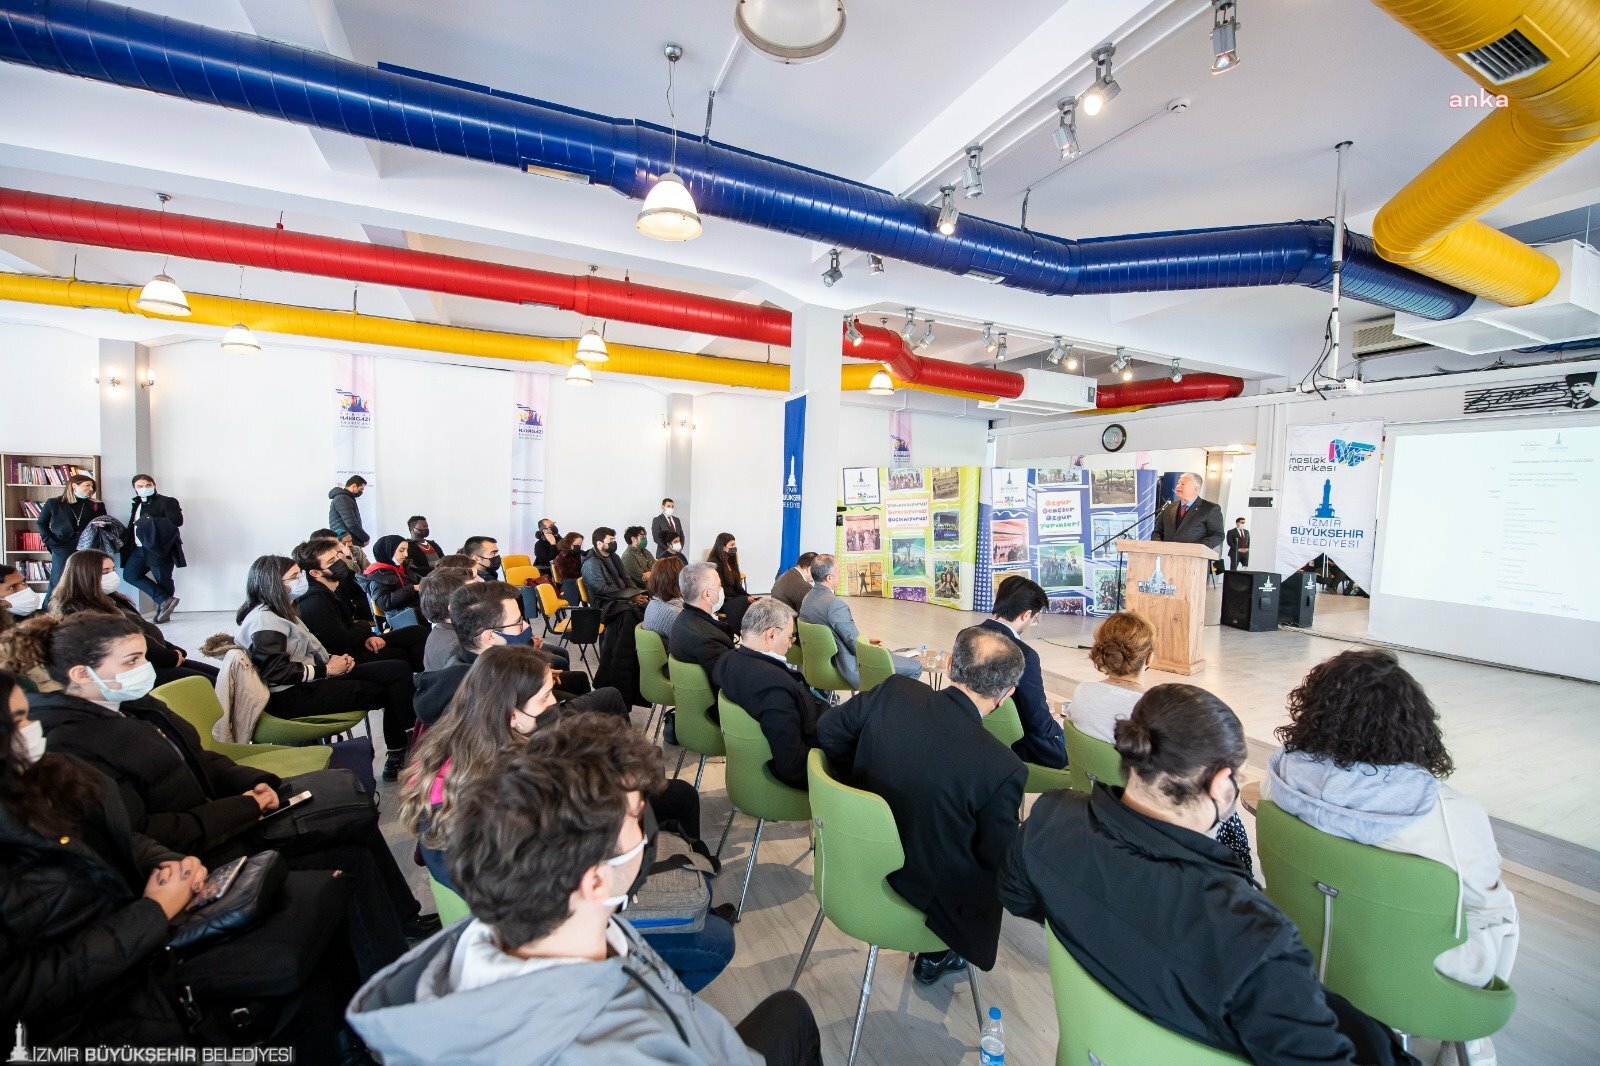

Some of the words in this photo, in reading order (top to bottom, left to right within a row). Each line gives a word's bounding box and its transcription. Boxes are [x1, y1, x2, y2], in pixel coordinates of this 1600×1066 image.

[1289, 456, 1327, 464] meslek
[1308, 518, 1342, 528] İZMİR
[1290, 526, 1364, 539] BÜYÜKŞEHİR
[1292, 536, 1360, 548] BELEDİYESİ
